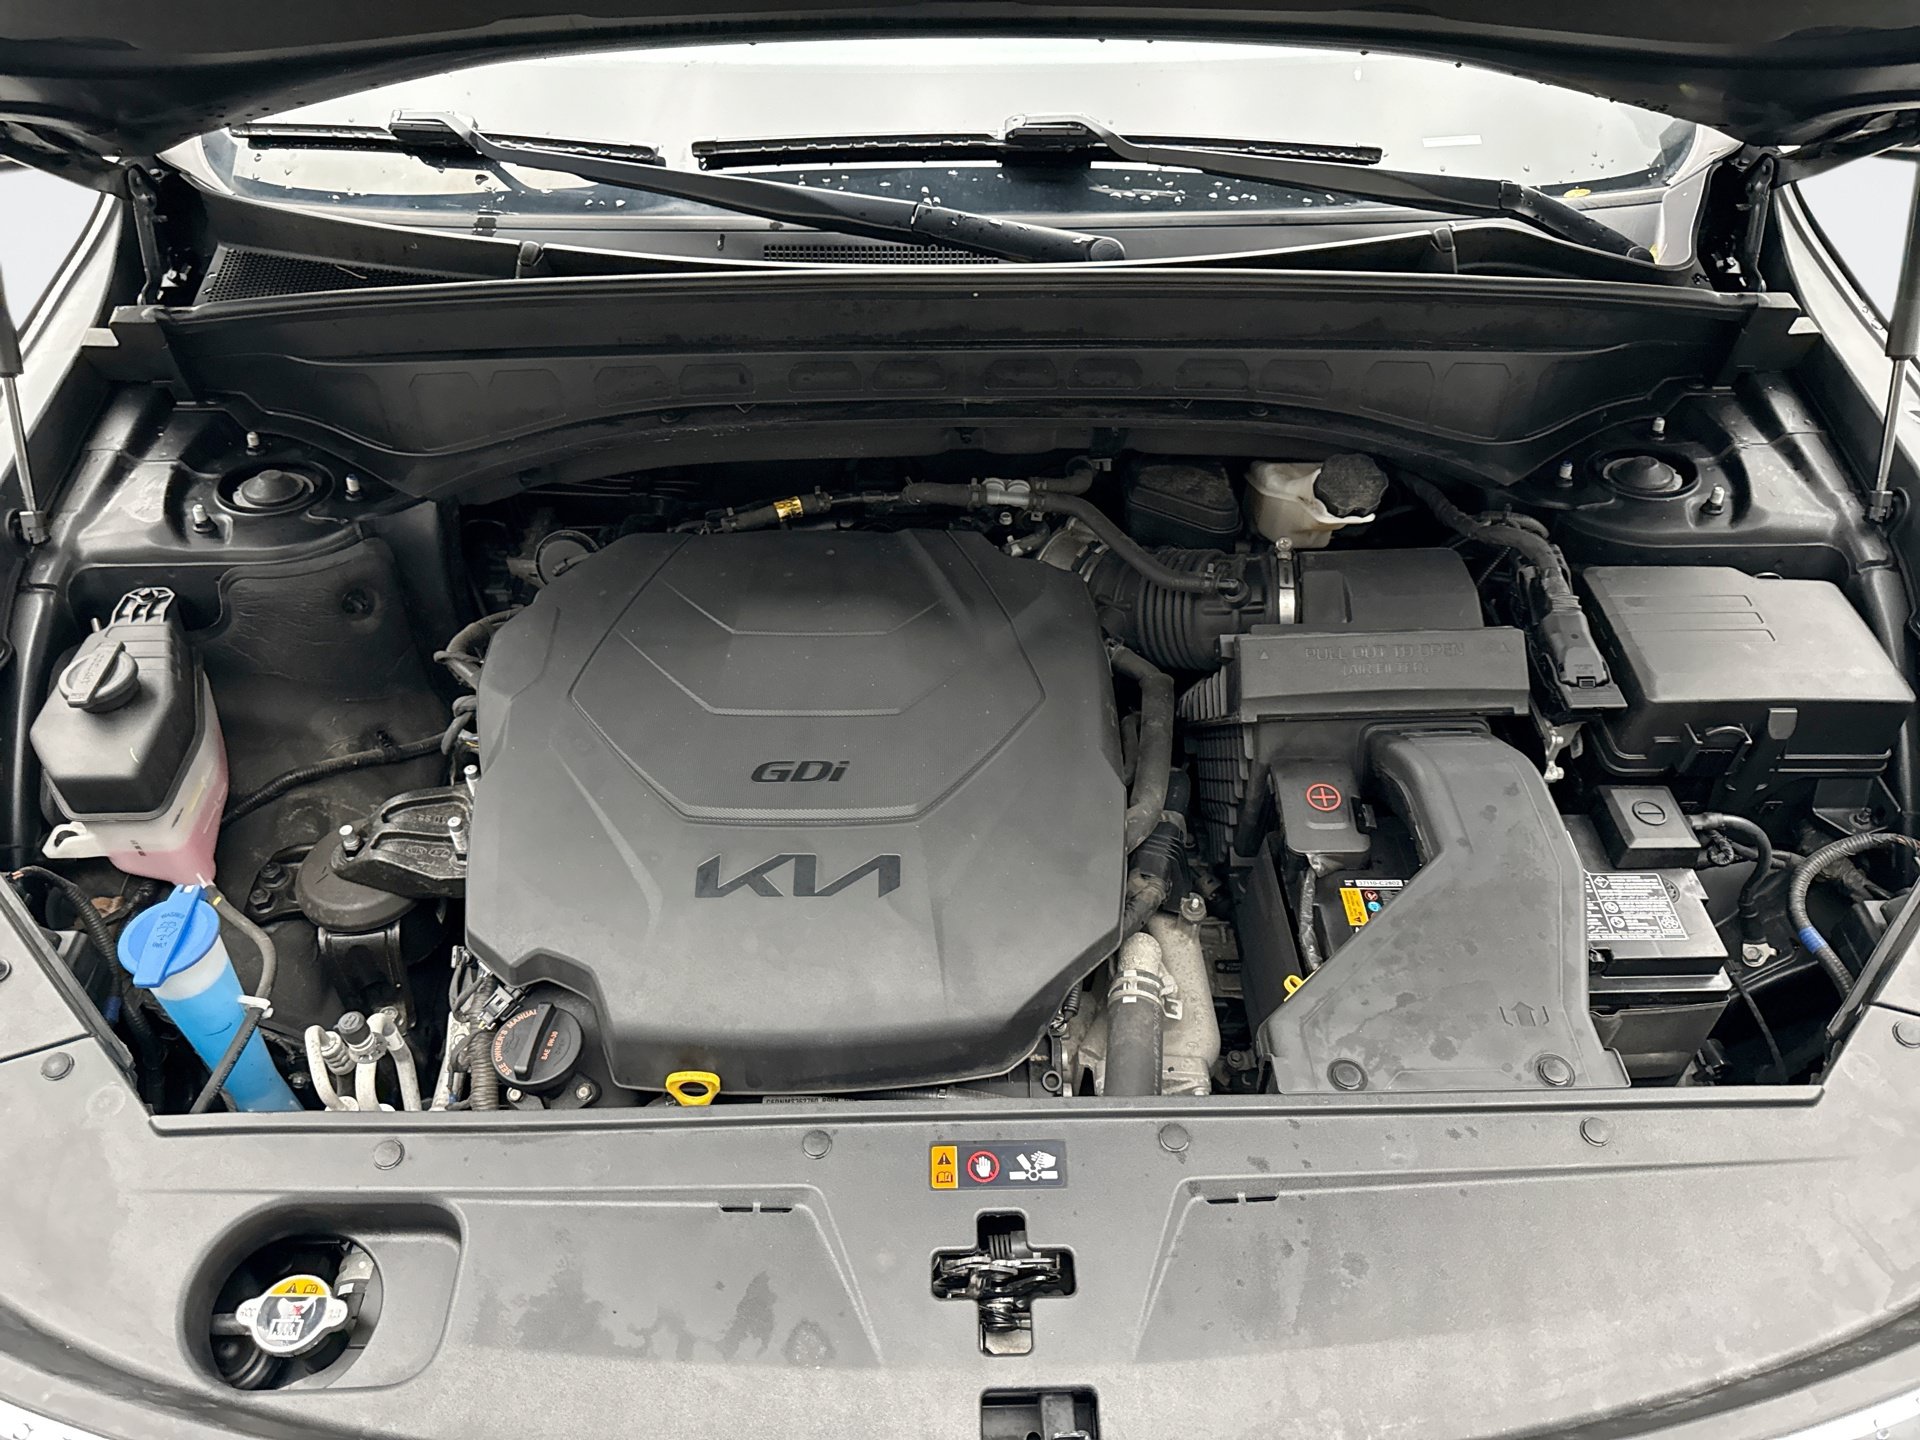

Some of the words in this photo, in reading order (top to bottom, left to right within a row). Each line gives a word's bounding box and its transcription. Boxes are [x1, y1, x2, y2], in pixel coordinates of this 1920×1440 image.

[1305, 647, 1348, 660] PULL
[1352, 644, 1385, 659] OUT
[1392, 643, 1413, 658] TO
[1418, 642, 1465, 657] OPEN
[751, 760, 850, 782] GDi
[695, 853, 901, 898] KIA
[494, 1029, 508, 1062] OWNER'S
[541, 1049, 551, 1060] SAE
[498, 1062, 512, 1076] SEE
